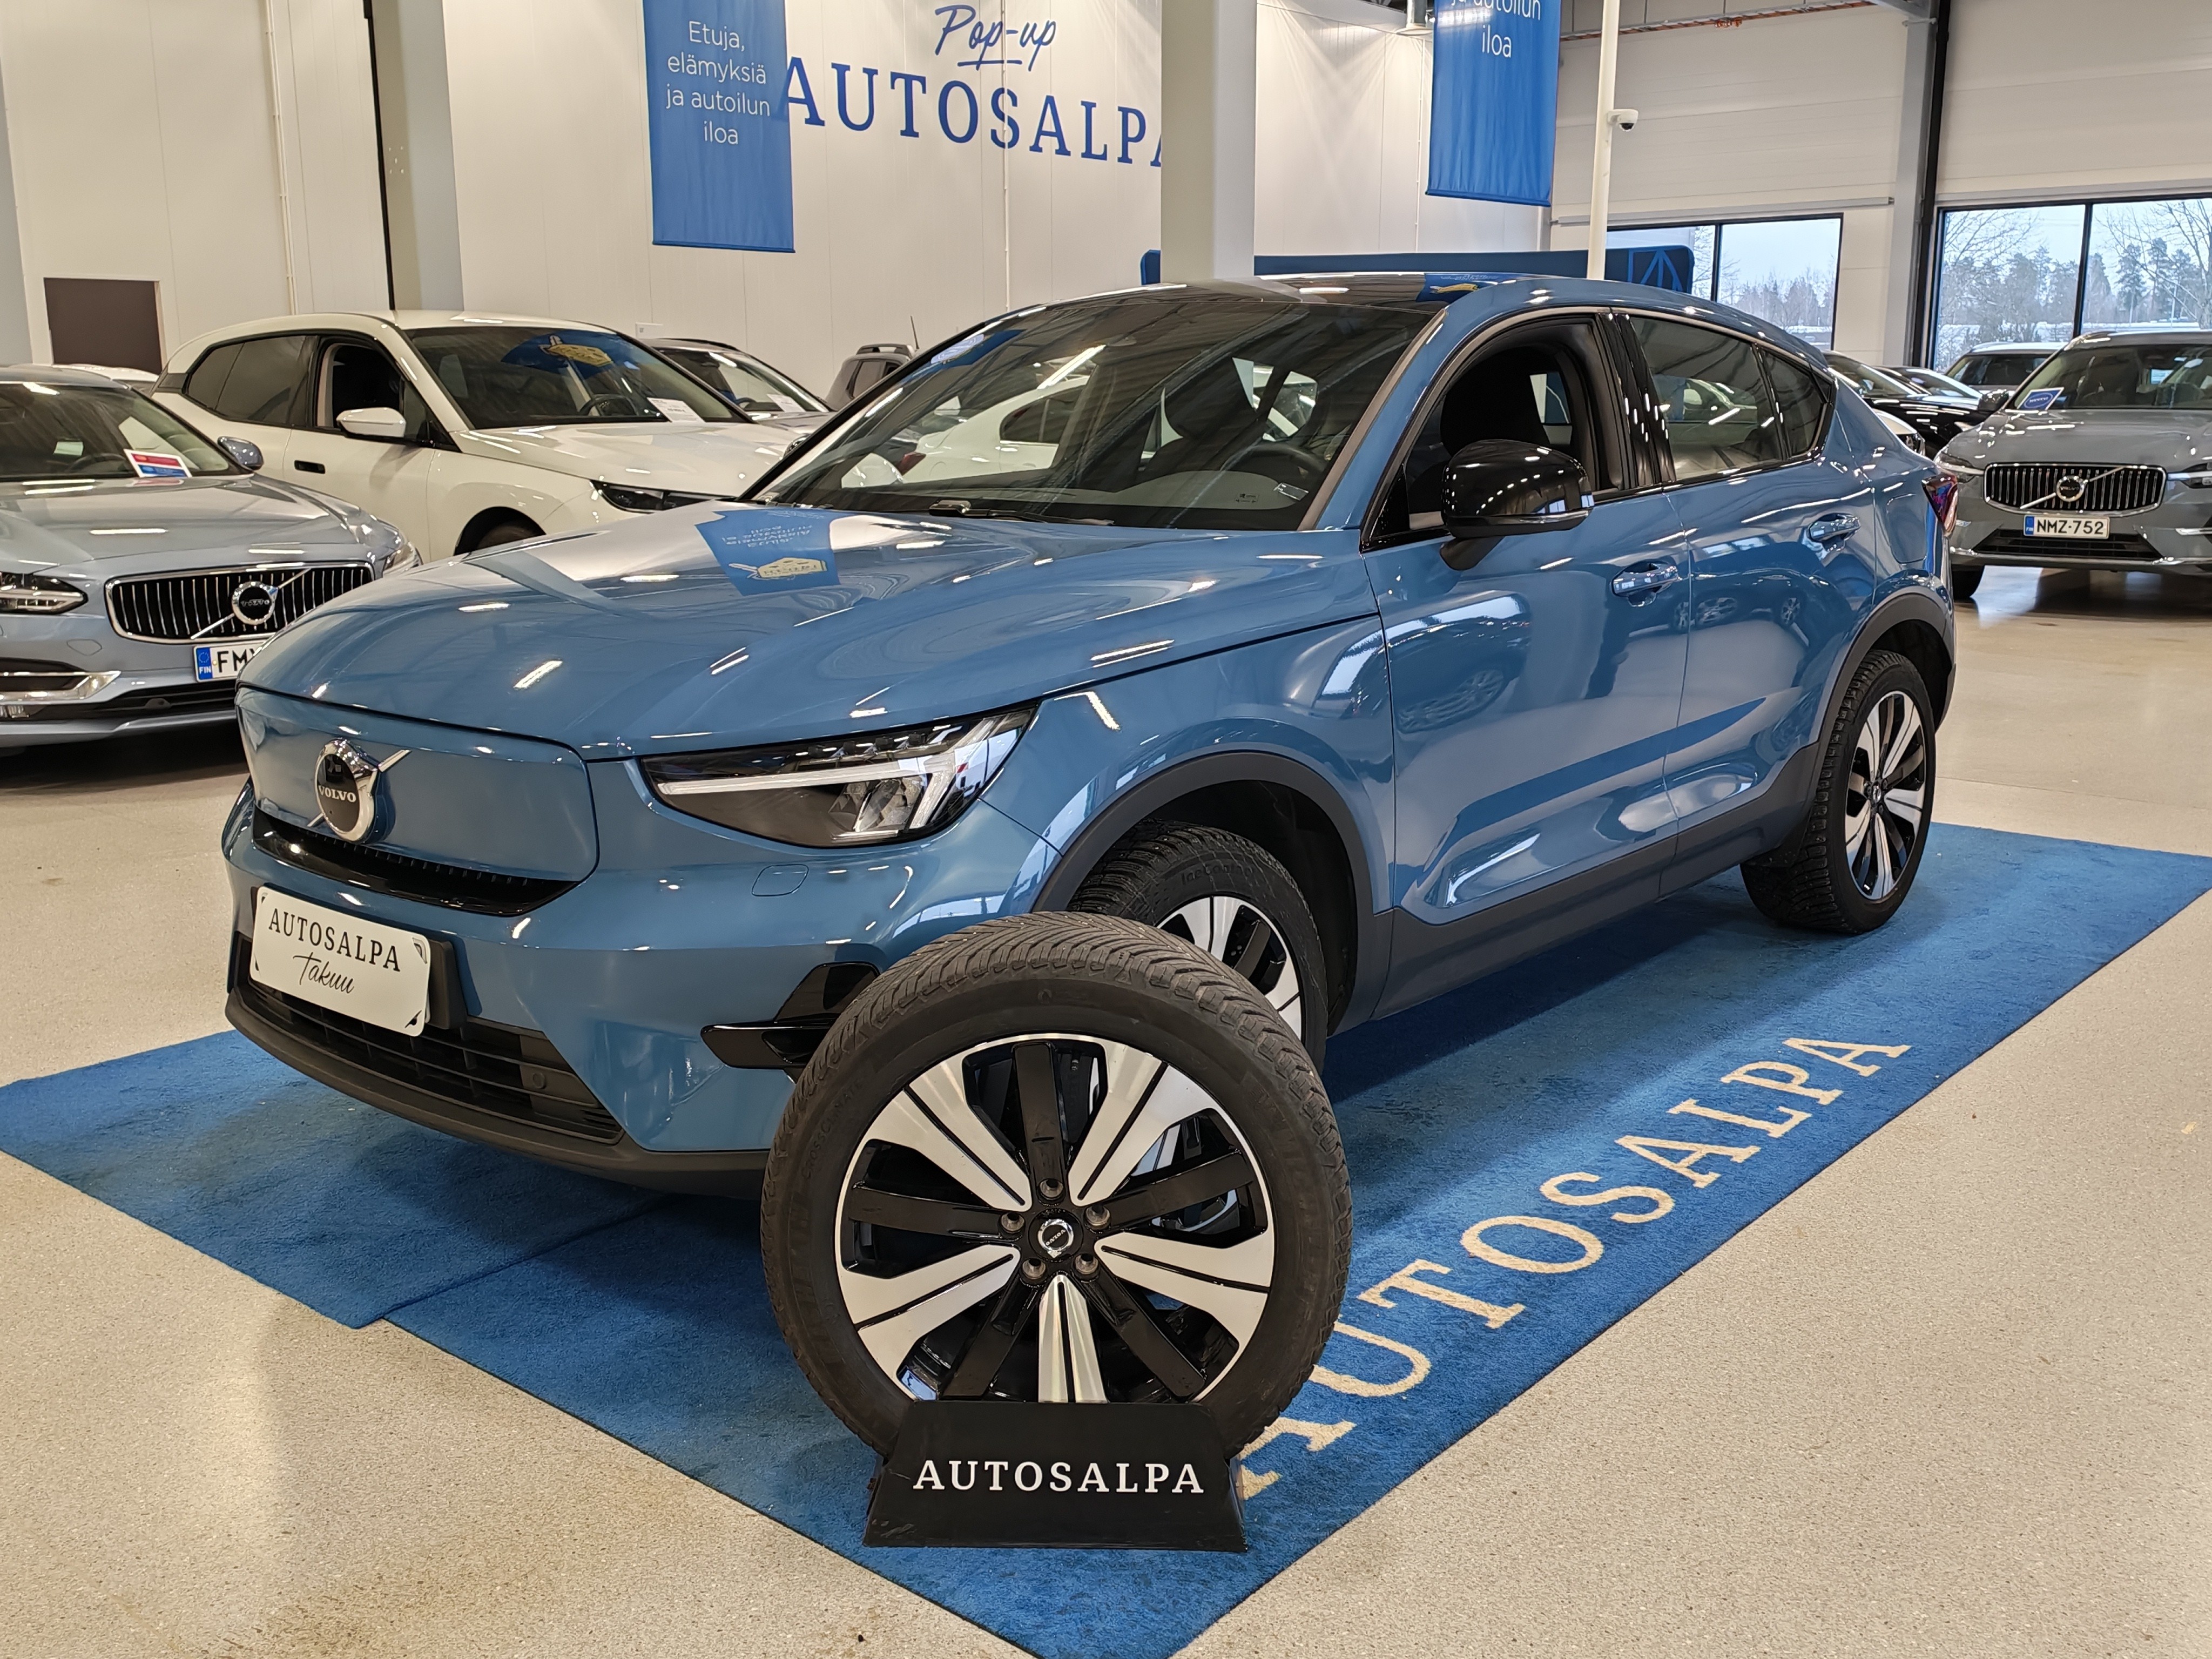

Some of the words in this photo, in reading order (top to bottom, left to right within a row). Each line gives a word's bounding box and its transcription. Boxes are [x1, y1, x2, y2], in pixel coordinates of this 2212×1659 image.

[689, 21, 745, 52] Etuja,
[935, 4, 1056, 71] Pop-up
[1482, 24, 1512, 58] iloa
[667, 51, 766, 84] elämyksiä
[666, 83, 684, 109] ja
[691, 90, 770, 117] autoilun
[784, 56, 1161, 167] AUTOSALP
[704, 120, 739, 145] iloa
[2037, 520, 2104, 535] NMZ-752
[199, 666, 212, 674] FIN
[217, 649, 255, 673] FM
[318, 784, 357, 803] VOLVO
[268, 908, 401, 973] AUTOSALPA
[292, 951, 355, 994] Takuu
[1046, 1229, 1066, 1246] VOLVO
[913, 1459, 1205, 1495] AUTOSALPA
